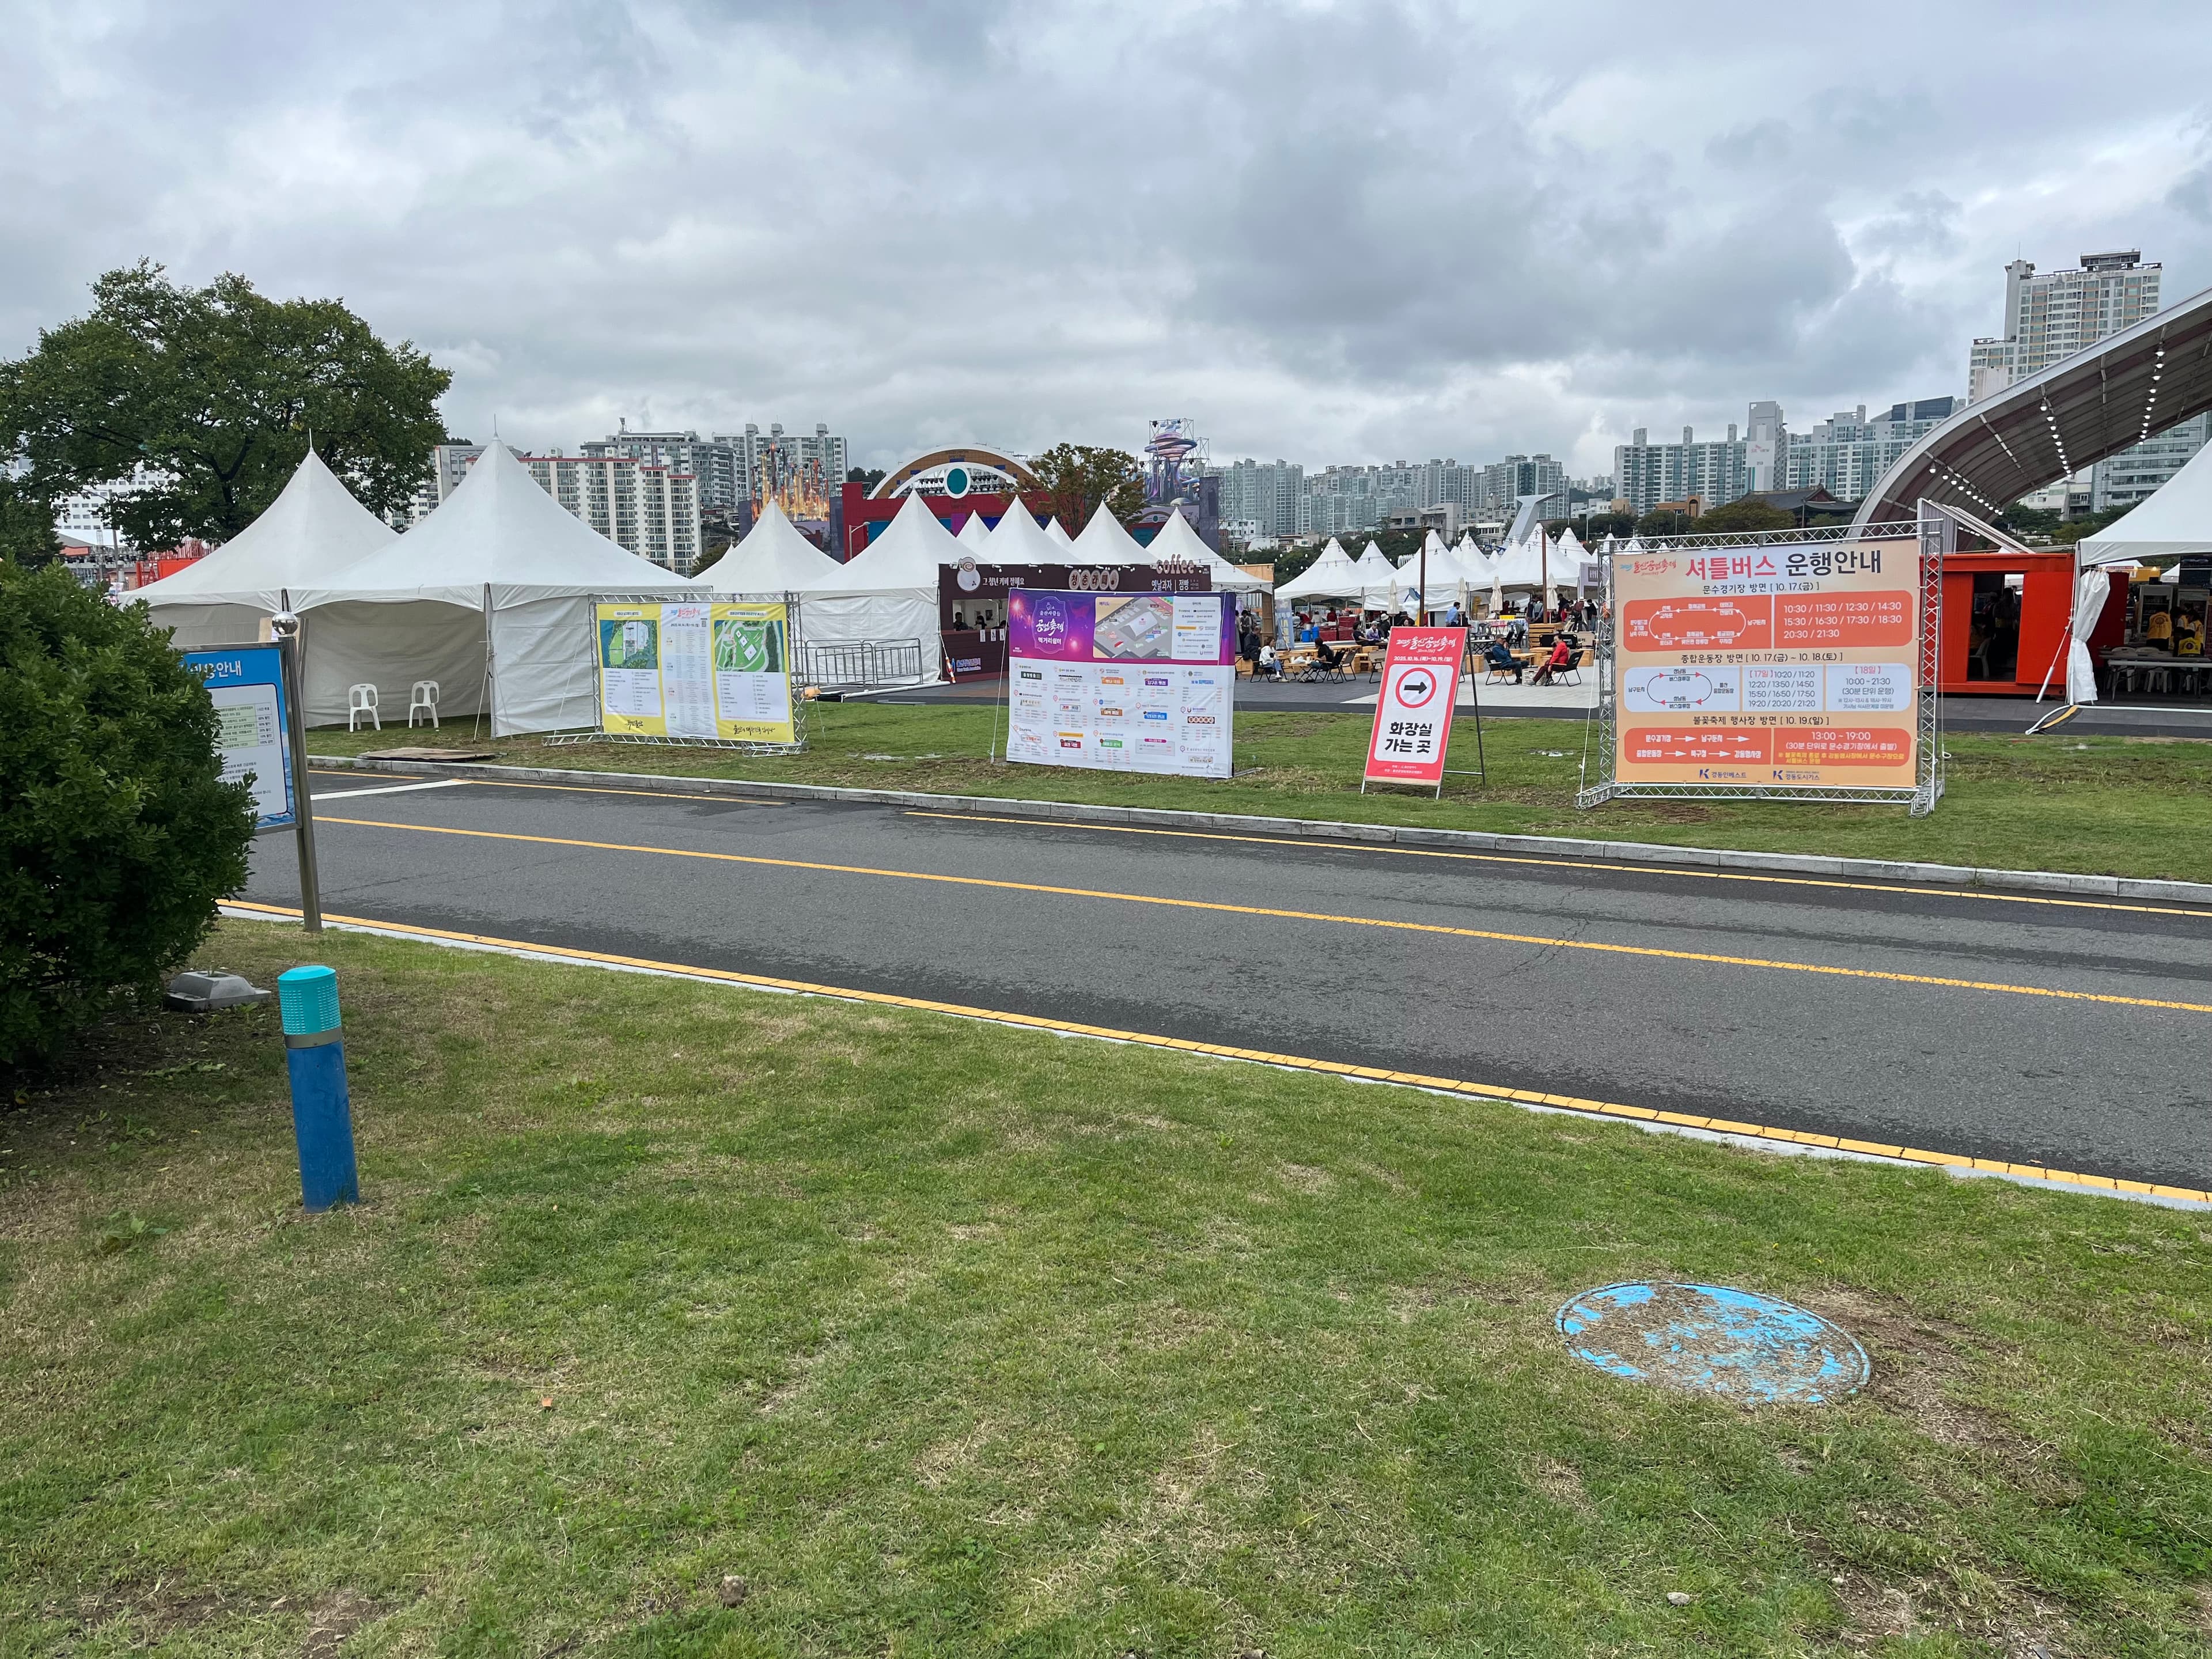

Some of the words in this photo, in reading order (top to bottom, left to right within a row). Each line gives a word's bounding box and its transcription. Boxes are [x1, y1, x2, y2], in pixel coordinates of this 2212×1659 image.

[2066, 272, 2093, 281] River
[1156, 554, 1194, 574] coffee
[1633, 558, 1677, 574] 울산공업축제
[1685, 555, 1777, 580] 셔틀버스
[1786, 550, 1881, 577] 운행안내
[1152, 579, 1172, 591] 옛날과자
[1703, 584, 1746, 594] 문수경기장
[1749, 583, 1766, 593] 방면
[1784, 604, 1806, 613] 10:30
[1815, 603, 1836, 612] 11:30
[1845, 603, 1868, 612] 12:30
[1877, 601, 1902, 611] 14:30
[1784, 618, 1806, 626] 15:30
[1815, 616, 1838, 625] 16:30
[1847, 615, 1869, 624] 17:30
[1878, 615, 1902, 624] 18:30
[1036, 618, 1065, 636] 공업축제
[1784, 630, 1808, 639] 20:30
[1817, 629, 1839, 638] 21:30
[1409, 635, 1457, 652] 울산공업축제
[1681, 654, 1723, 664] 종합운동장
[1726, 654, 1743, 663] 방면
[1755, 670, 1768, 678] 17일
[1861, 666, 1876, 674] 18일
[1842, 687, 1860, 695] (30분
[1877, 687, 1894, 695] 운행)
[1693, 716, 1726, 725] 불꽃축제
[1730, 716, 1756, 725] 행사장
[1760, 716, 1777, 725] 방면
[1389, 722, 1433, 736] 화장실
[1645, 734, 1672, 743] 문수경기장
[1701, 734, 1723, 743] 남구둔치
[1811, 732, 1836, 740] 13:00
[1846, 732, 1871, 740] 19:00
[1385, 738, 1412, 753] 가는
[1416, 739, 1431, 754] 곳
[1829, 743, 1878, 751] 문수경기장에서
[1637, 749, 1662, 757] 종합운동장
